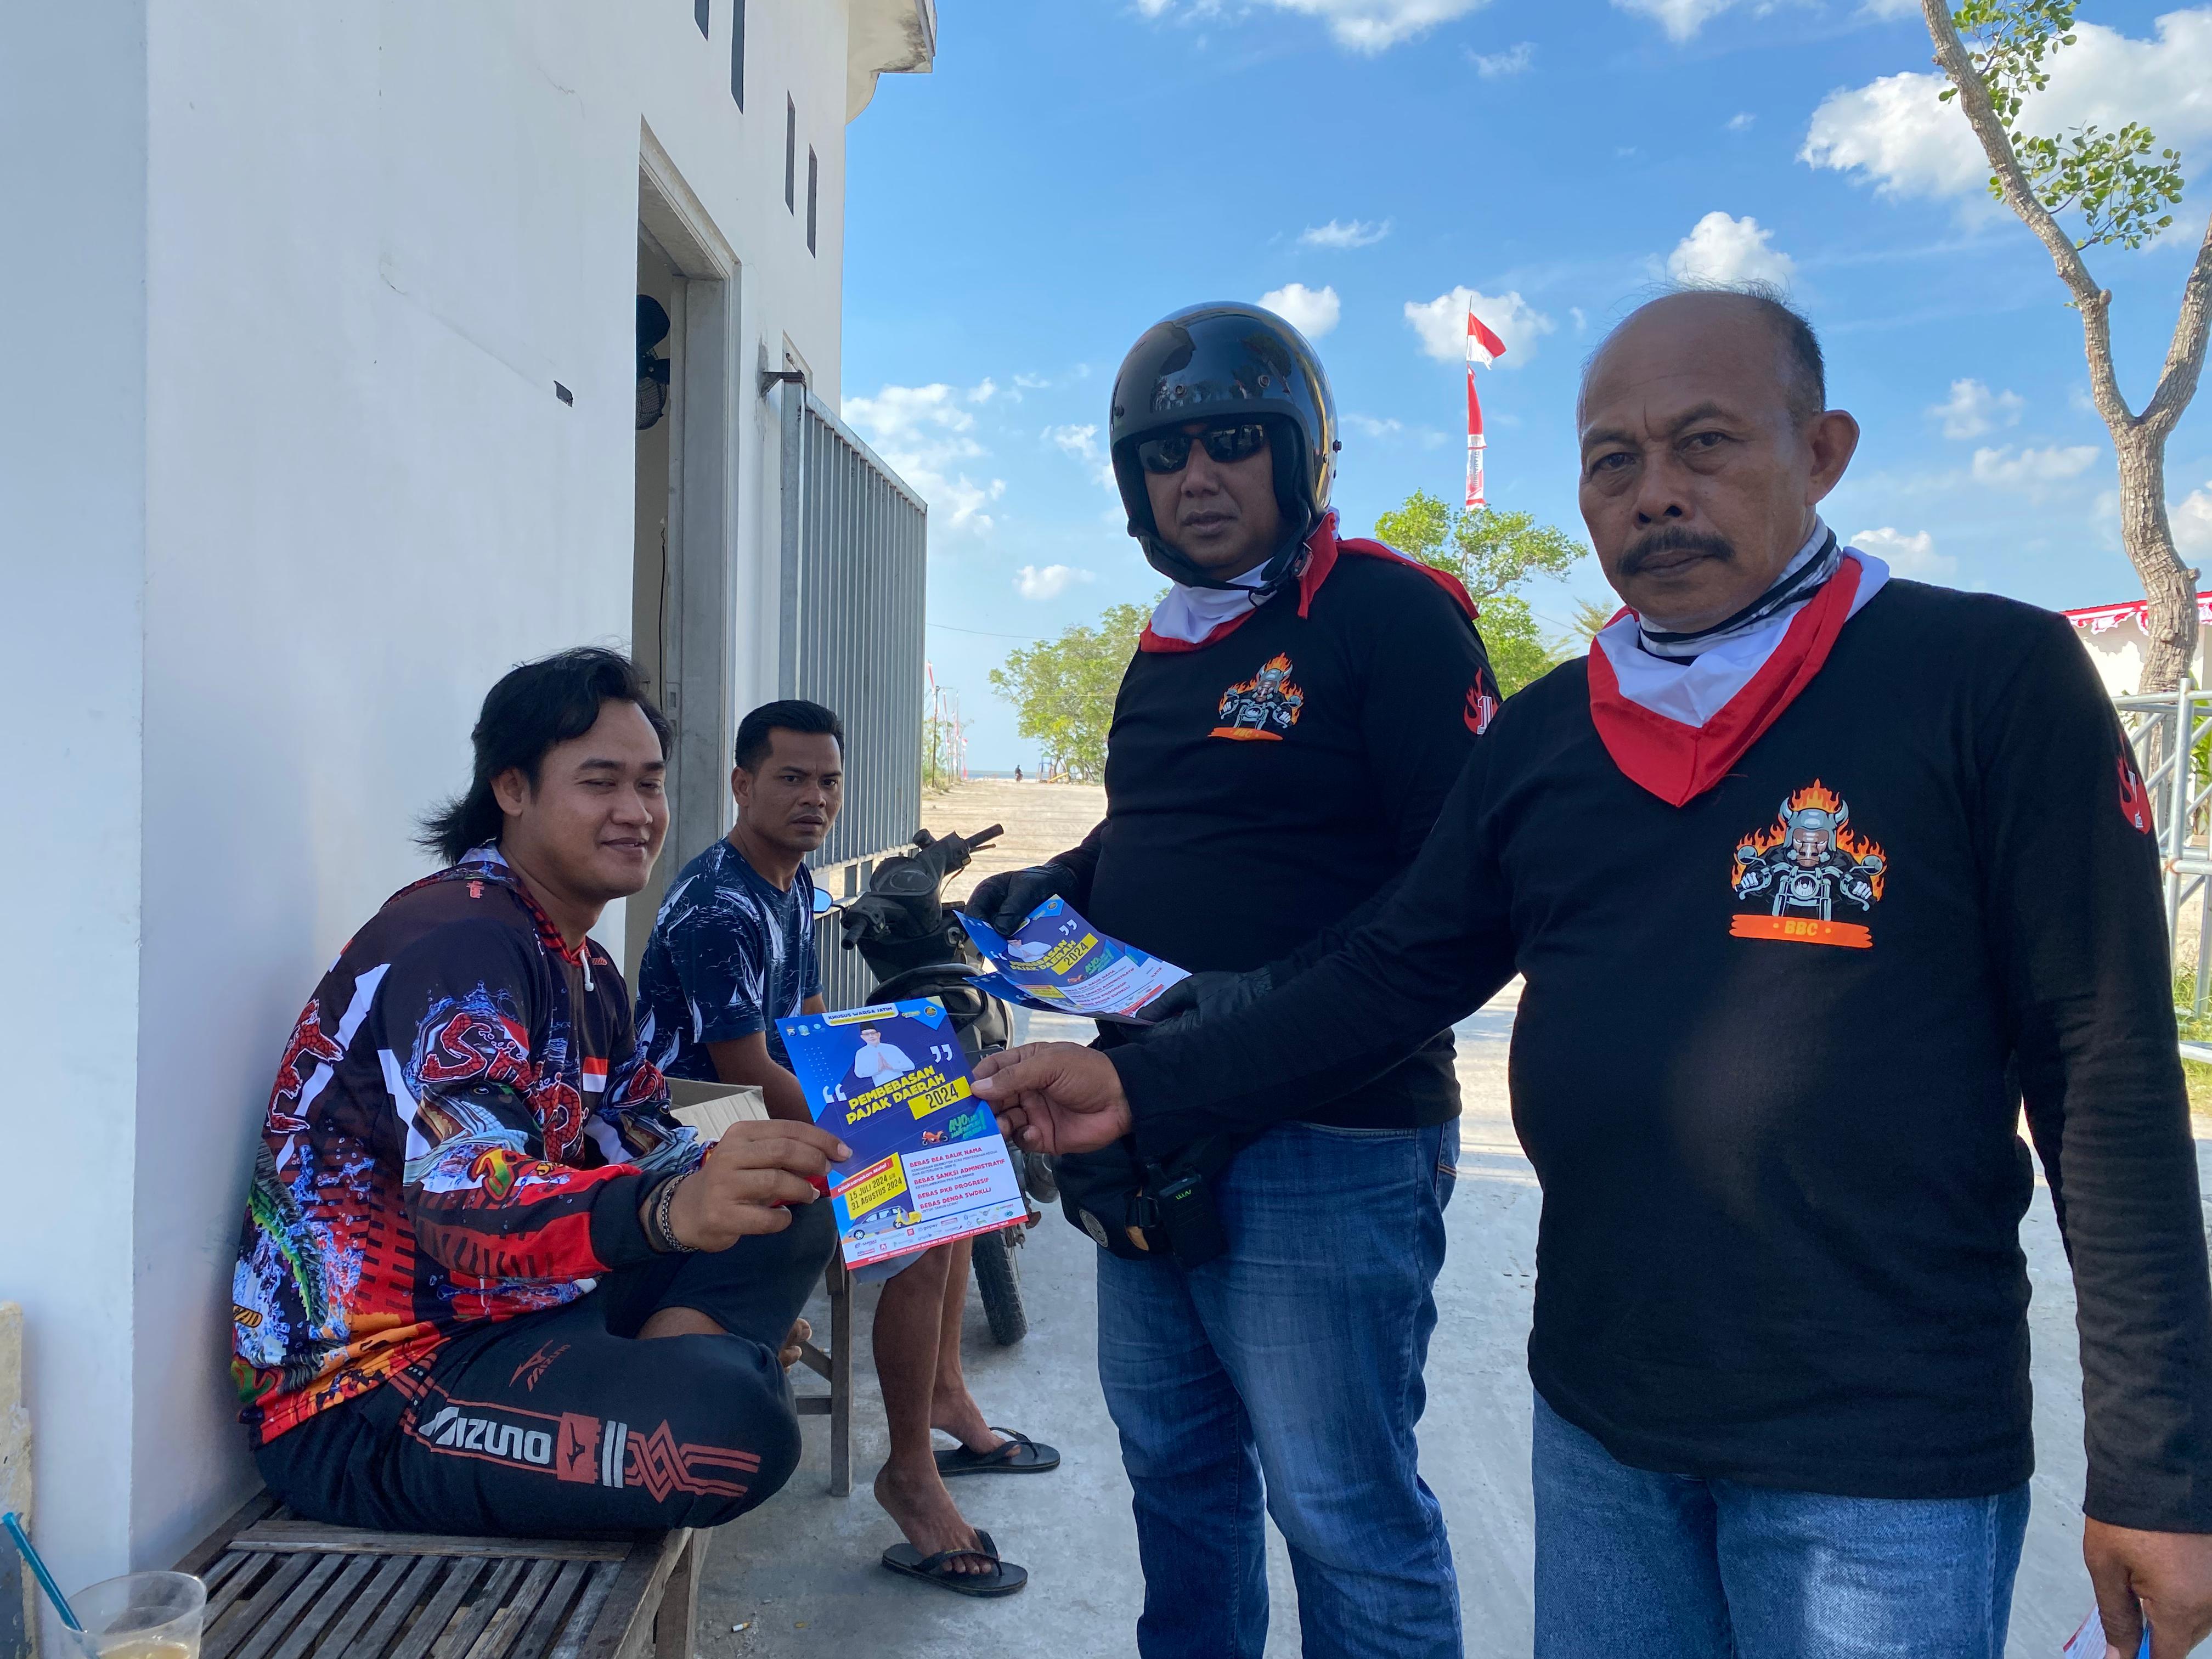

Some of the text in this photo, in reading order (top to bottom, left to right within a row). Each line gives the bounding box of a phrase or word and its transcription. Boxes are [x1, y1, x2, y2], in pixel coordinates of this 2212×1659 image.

[1784, 921, 1818, 935] BBC
[1039, 940, 1076, 970] DAERAH
[1063, 942, 1089, 966] 2024
[845, 1073, 946, 1125] PAJAK DAERAH
[848, 1065, 935, 1110] PEMBEBASAN
[926, 1083, 959, 1109] 2024
[910, 1159, 930, 1167] BEBAS
[914, 1159, 1005, 1185] BEBAS SANKSI ADMINISTRATIF
[837, 1172, 873, 1193] Dilaksanakan
[849, 1191, 857, 1201] 15
[859, 1183, 872, 1196] JULI
[872, 1175, 888, 1188] 2024
[851, 1177, 902, 1210] 31 AGUSTUS 2024
[917, 1189, 938, 1199] BEBAS
[954, 1177, 990, 1190] PROGRESIF
[919, 1200, 940, 1209] BEBAS
[942, 1194, 964, 1203] DENDA
[417, 1407, 551, 1465] MIZUNO
